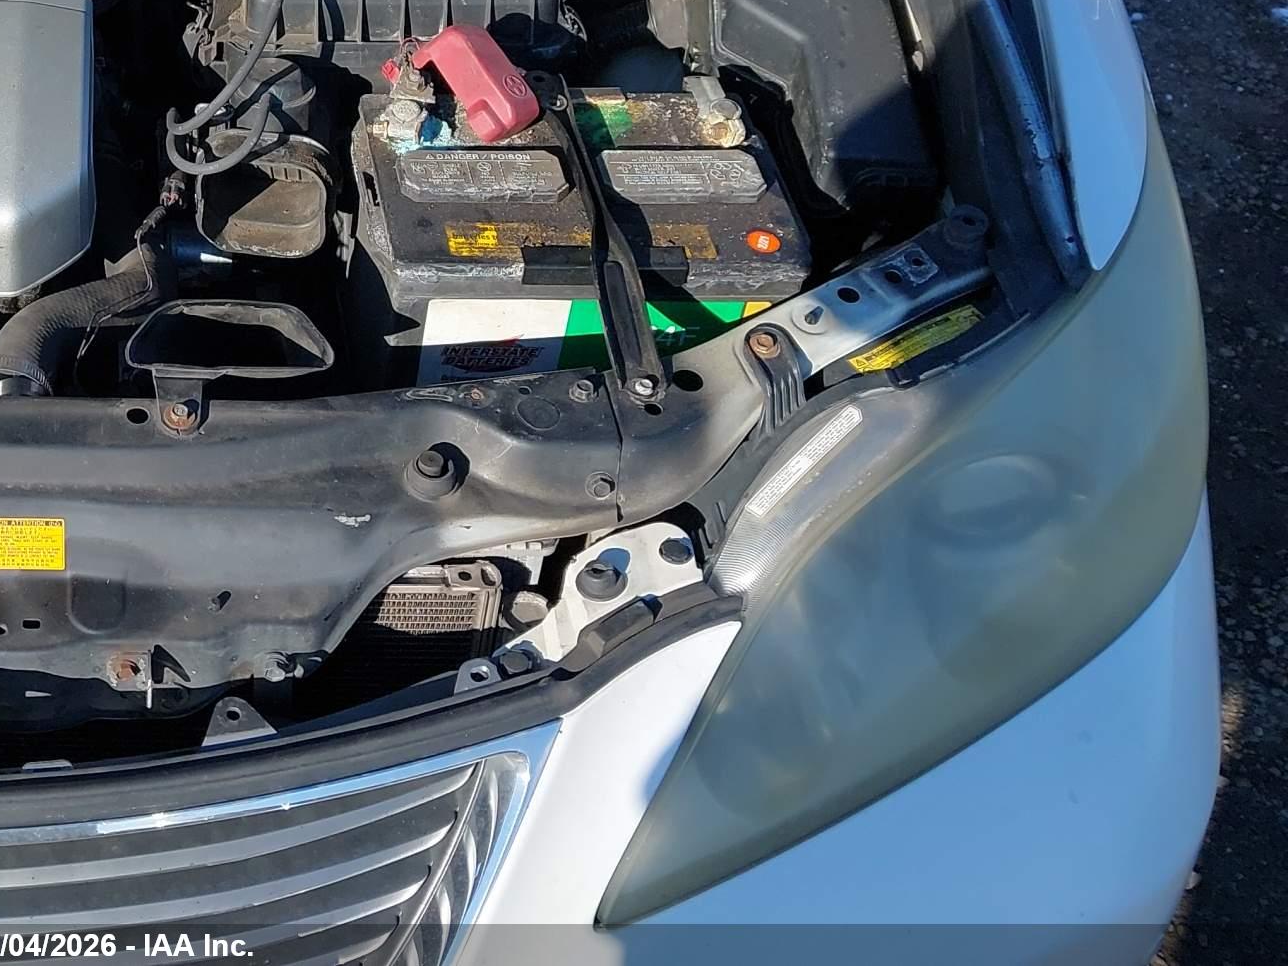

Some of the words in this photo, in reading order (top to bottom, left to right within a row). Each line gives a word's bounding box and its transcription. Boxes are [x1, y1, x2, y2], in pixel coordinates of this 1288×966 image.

[436, 152, 480, 160] DANGER
[490, 152, 531, 160] POISON
[441, 345, 544, 358] INTERSTATE
[441, 356, 532, 367] BATTERIES
